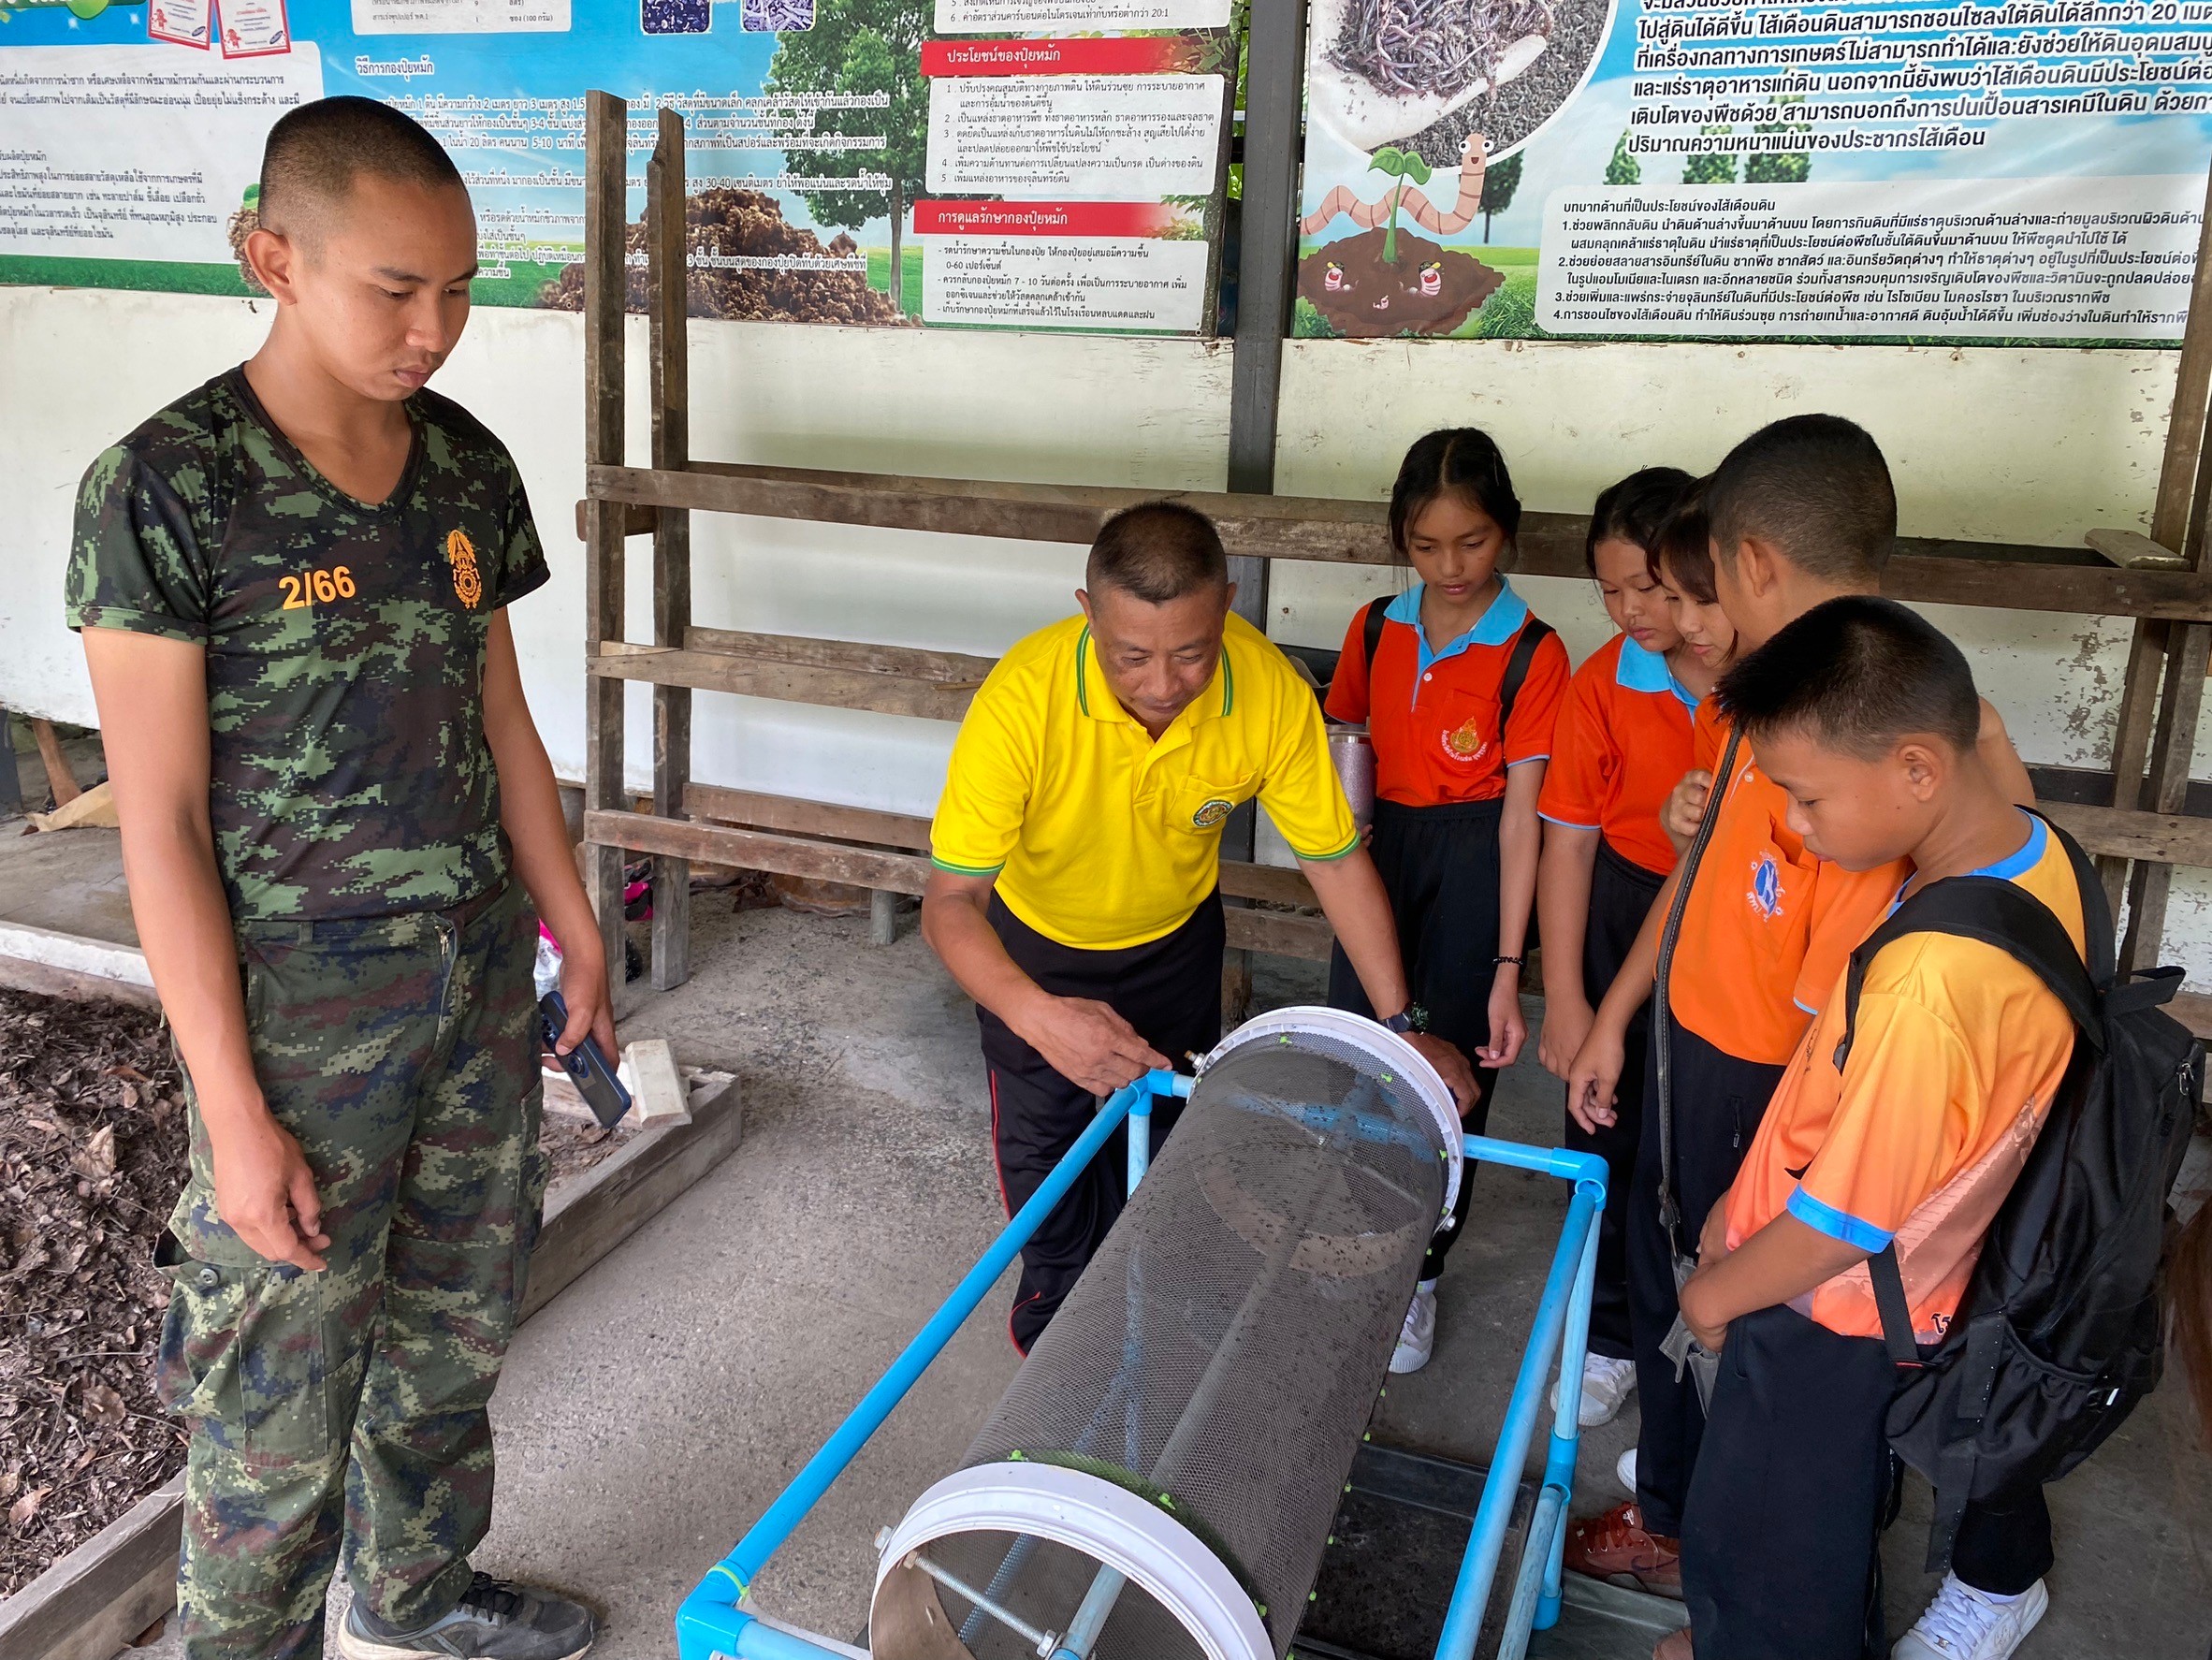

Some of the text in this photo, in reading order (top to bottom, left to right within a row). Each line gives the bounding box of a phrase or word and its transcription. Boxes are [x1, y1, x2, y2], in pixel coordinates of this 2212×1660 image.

[1152, 7, 1169, 18] 20:1
[1639, 11, 1753, 45] ไปสู่ดินได้ดีขึ้น
[2152, 4, 2177, 21] 20
[947, 43, 1061, 68] ประโยชน์ของปุ๋ยหมัก
[357, 57, 434, 79] วิธีการกองปุ๋ยหมัก
[484, 100, 490, 109] 2
[492, 100, 511, 109] เมตร
[514, 100, 528, 109] ยาว
[531, 100, 536, 109] 3
[540, 100, 558, 109] เมตร
[656, 99, 662, 109] 2
[1631, 103, 1776, 124] เติบโตของพืชด้วย
[531, 118, 544, 128] 3-4
[470, 138, 479, 147] 20
[482, 134, 497, 147] ลิตร
[533, 138, 551, 148] 5-10
[557, 135, 574, 148] นาที
[1629, 126, 1986, 152] ปริมาณความหนาแน่นของประชากรไส้เดือน
[706, 178, 731, 188] 30-40
[1564, 197, 1776, 212] บทบาทด้านที่เป็นประโยชน์ของไส้เดือนดิน
[939, 207, 1068, 231] การดูแลรักษากองปุ๋ยหมัก
[1571, 236, 1705, 253] ผสมคลุกเคล้าแร่ธาตุในดิน
[2112, 231, 2128, 245] ได้
[946, 261, 964, 269] 0-60
[1863, 291, 1883, 302] เช่น
[279, 566, 356, 610] 2/66
